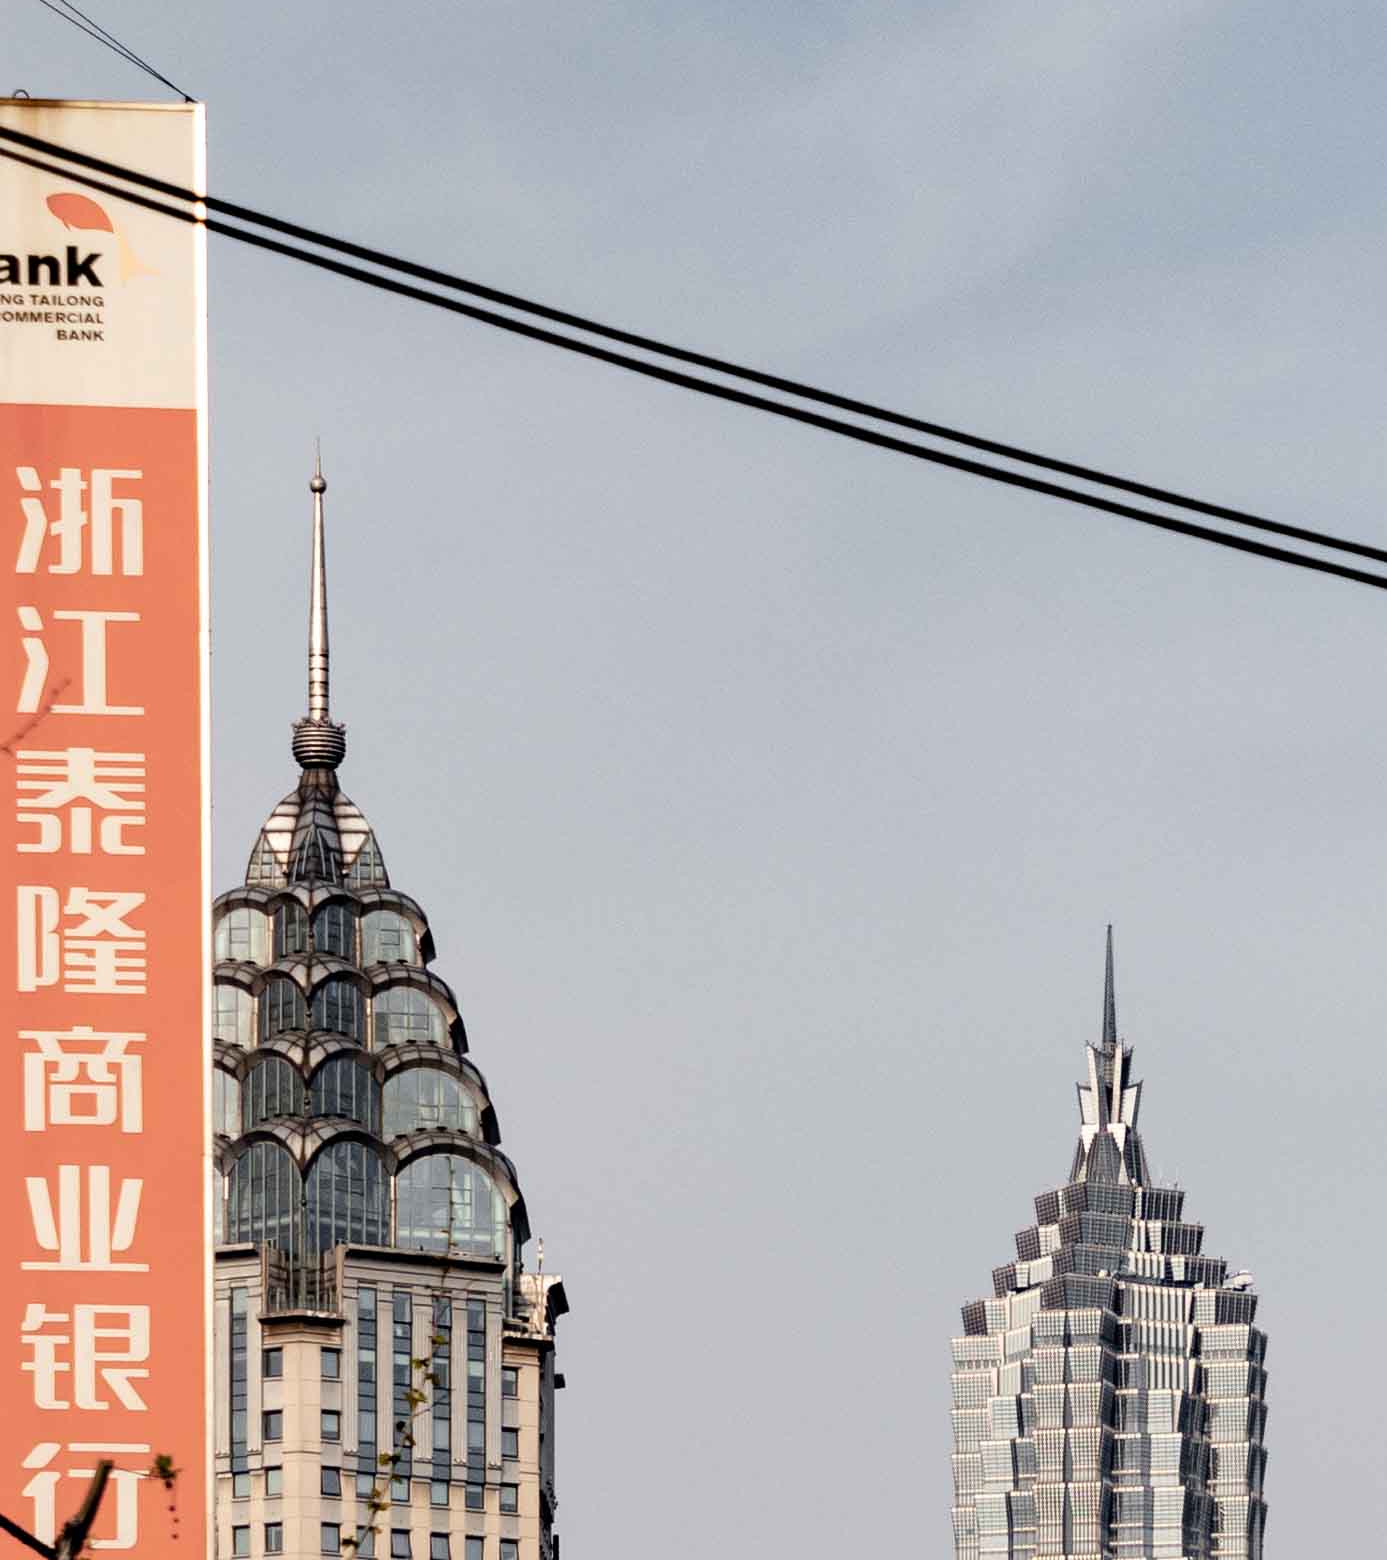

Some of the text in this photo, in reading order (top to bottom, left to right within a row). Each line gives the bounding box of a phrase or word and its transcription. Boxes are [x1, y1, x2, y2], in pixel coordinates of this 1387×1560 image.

[29, 293, 104, 307] TAILONG
[56, 329, 104, 342] BANK
[15, 466, 151, 1550] 浙江泰隆商业银行
